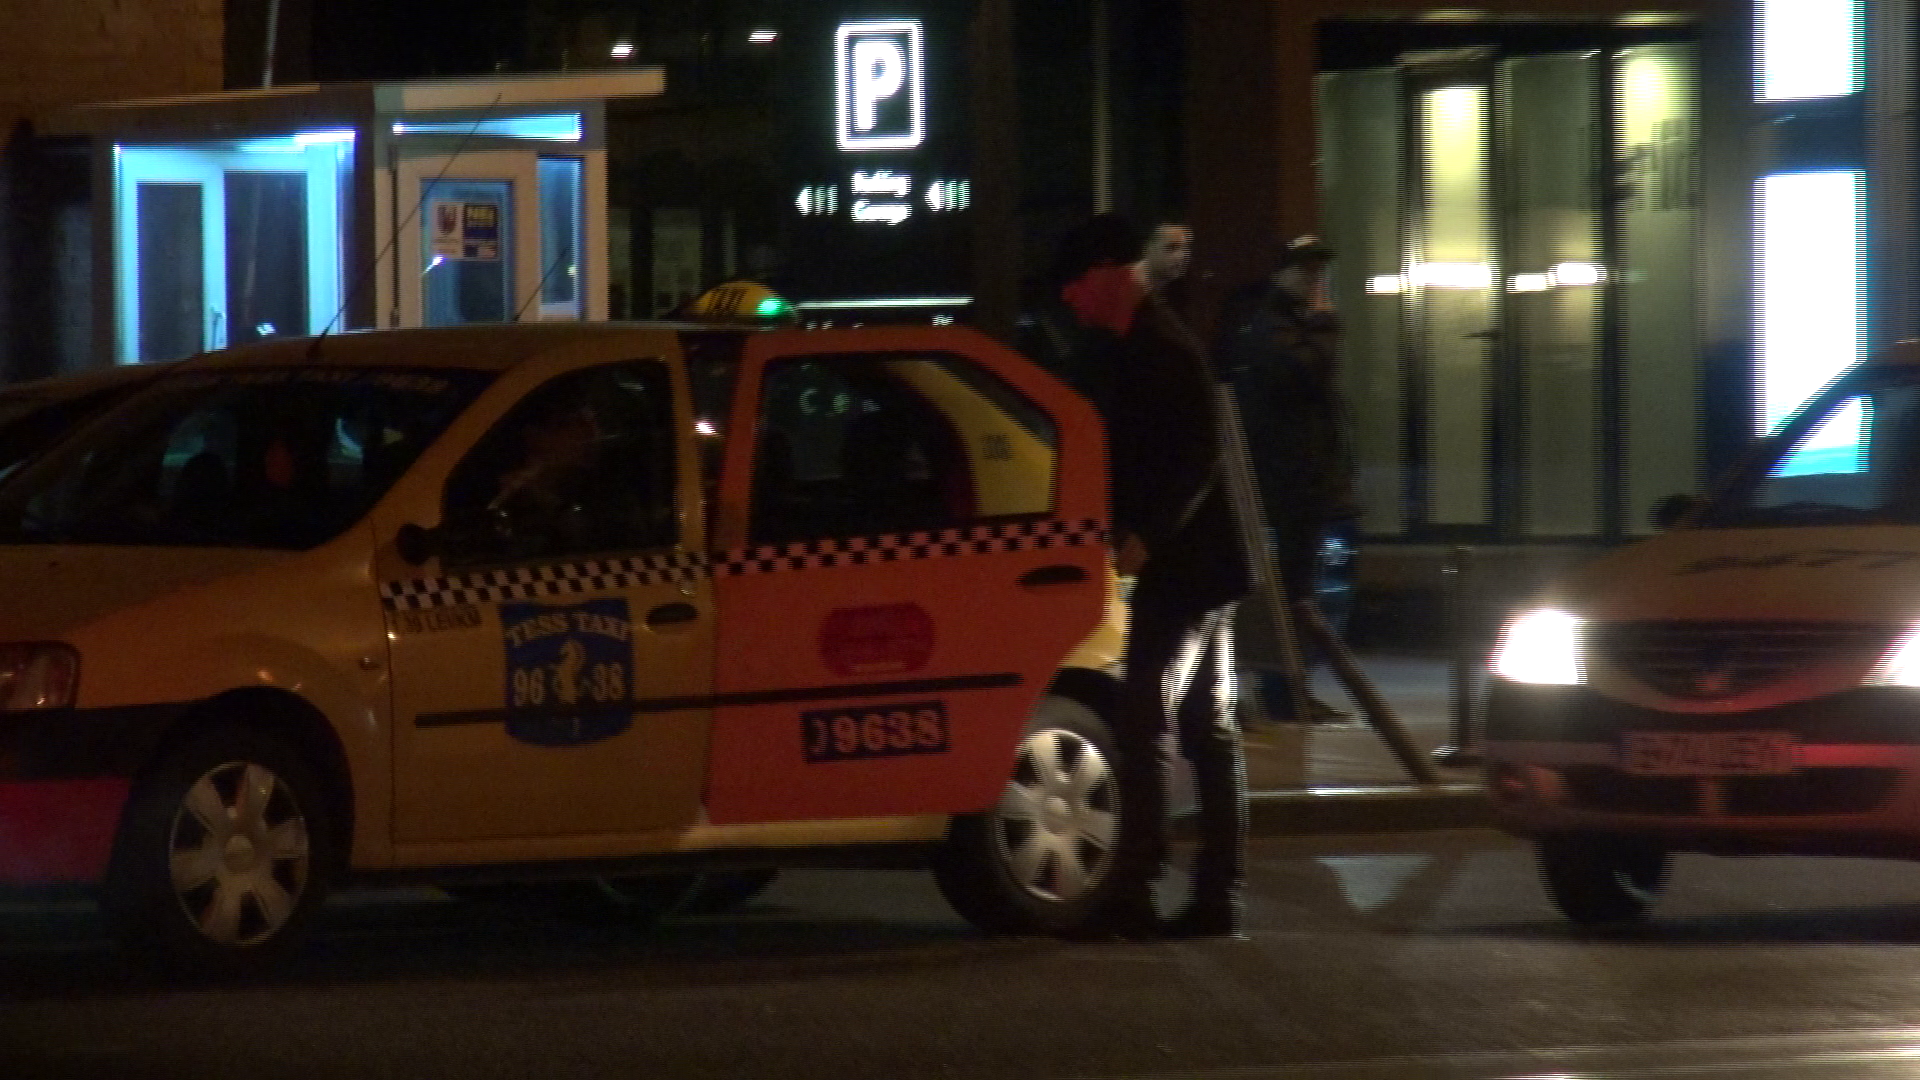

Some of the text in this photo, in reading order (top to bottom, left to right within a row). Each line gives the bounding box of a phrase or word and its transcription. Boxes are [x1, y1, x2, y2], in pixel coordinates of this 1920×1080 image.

[853, 40, 906, 131] P
[706, 288, 748, 317] TAXI
[507, 612, 631, 648] TESS TAXI
[513, 662, 626, 707] 96 38
[830, 709, 943, 753] 9638
